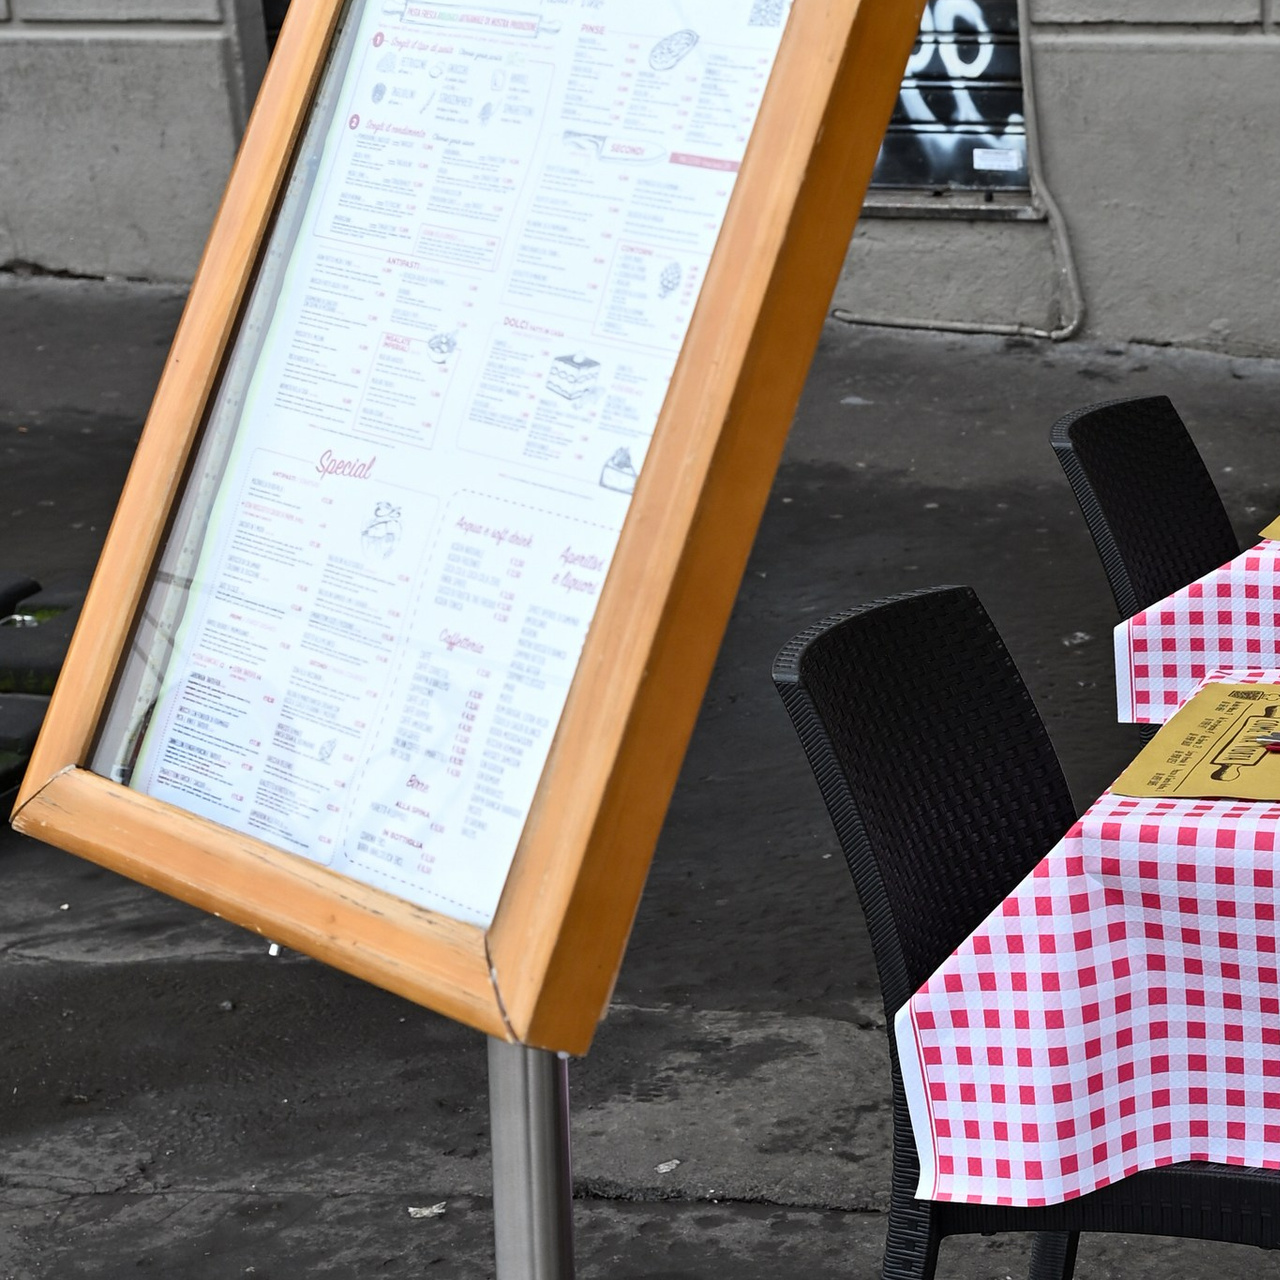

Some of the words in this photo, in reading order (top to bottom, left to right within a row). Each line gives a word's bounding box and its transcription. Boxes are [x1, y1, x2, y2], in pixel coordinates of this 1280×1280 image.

[581, 24, 606, 35] PINSE
[610, 143, 646, 156] SECONDI
[387, 256, 421, 270] ANTIPASTI
[503, 316, 529, 330] DOLCI
[315, 448, 377, 481] Special
[395, 800, 411, 812] ALLA
[392, 831, 424, 850] BOTTIGLIA
